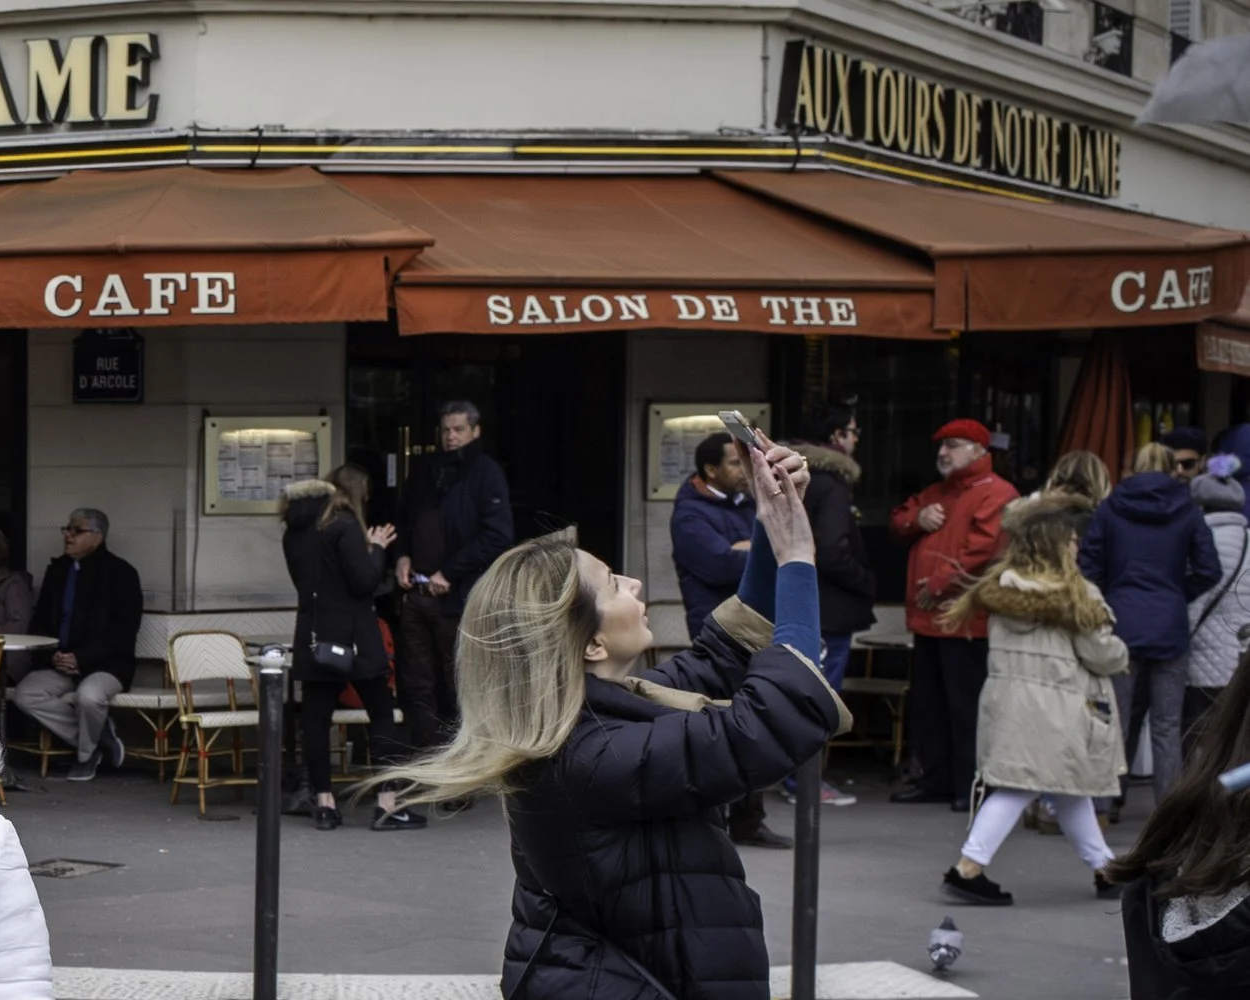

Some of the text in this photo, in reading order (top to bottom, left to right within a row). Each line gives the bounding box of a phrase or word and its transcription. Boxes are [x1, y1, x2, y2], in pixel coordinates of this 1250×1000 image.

[794, 46, 1121, 197] AUX TOURS DE NOTRE DAME
[44, 272, 236, 318] CAFE
[486, 294, 858, 326] SALON DE THE
[1110, 265, 1213, 313] CAFE
[96, 356, 120, 371] RUE
